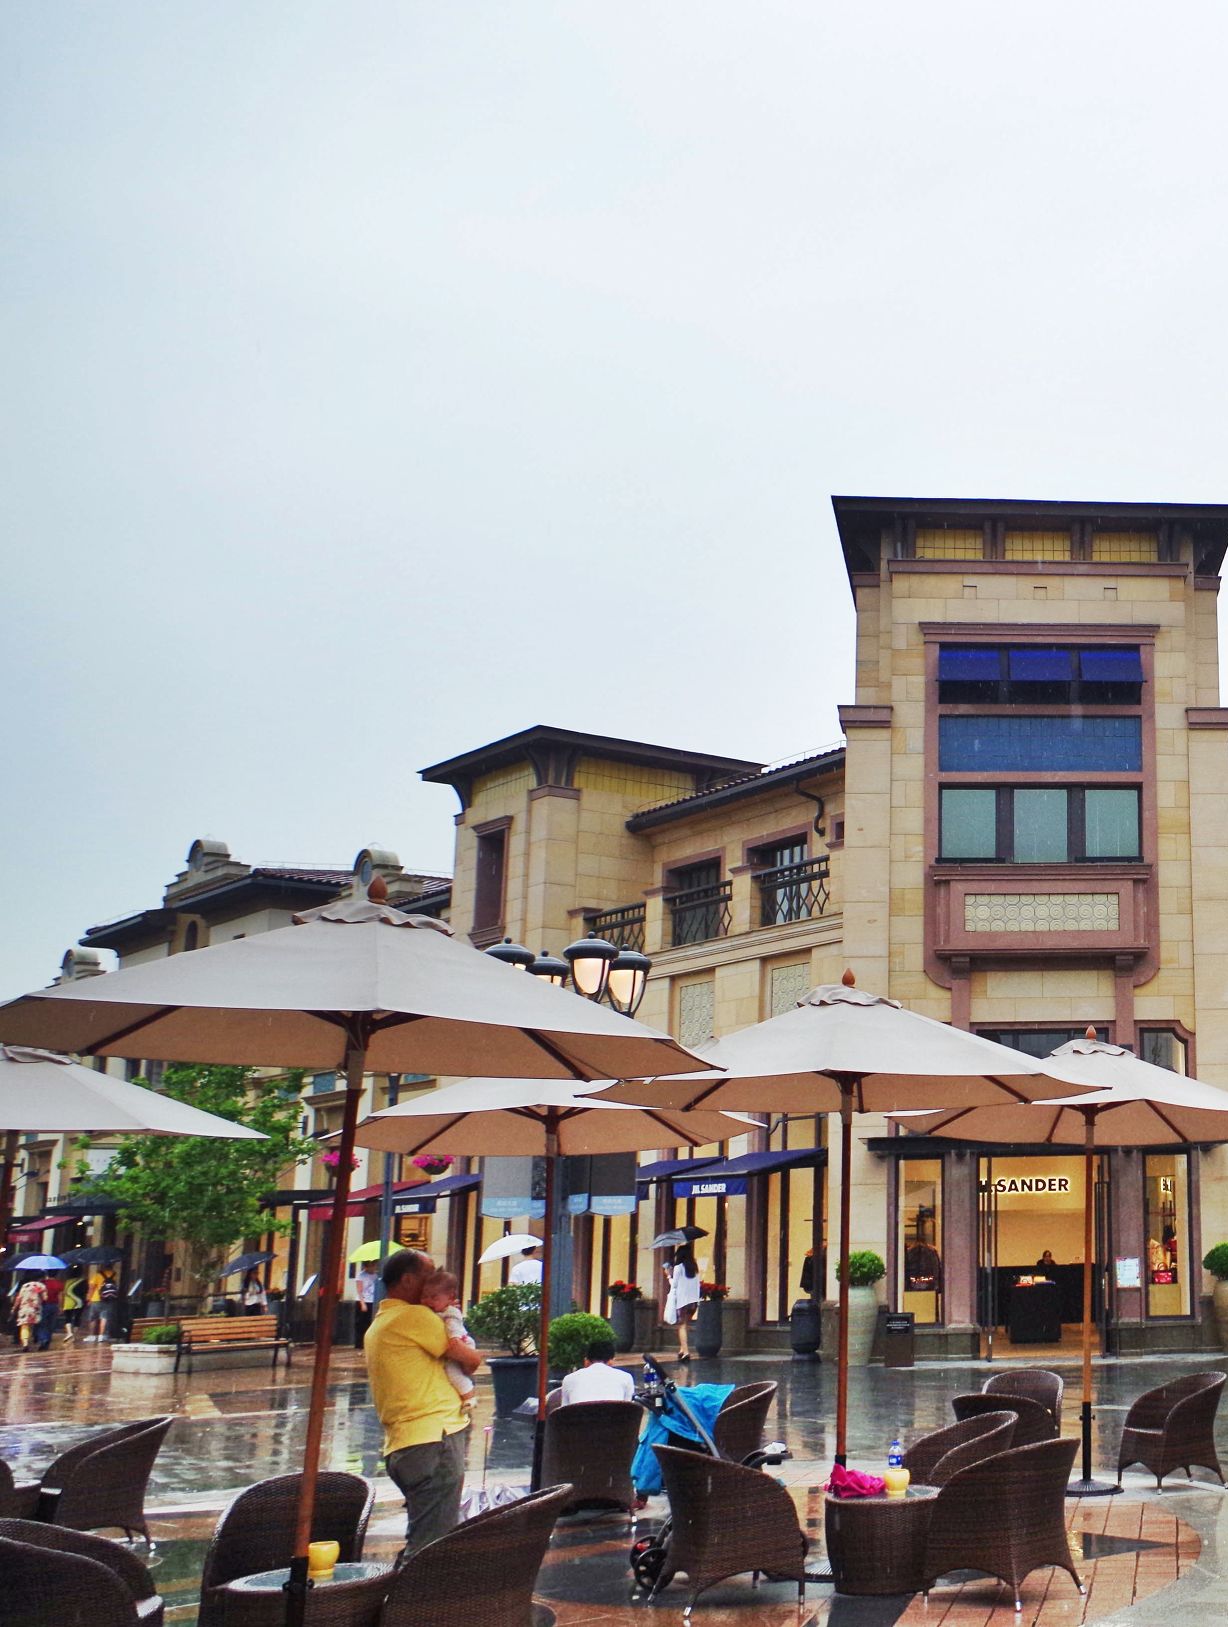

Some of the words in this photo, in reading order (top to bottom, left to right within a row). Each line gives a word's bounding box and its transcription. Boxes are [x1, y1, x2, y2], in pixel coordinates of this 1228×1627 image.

[692, 1185, 700, 1194] JIL
[701, 1183, 727, 1193] SANDER
[995, 1178, 1069, 1193] SANDER
